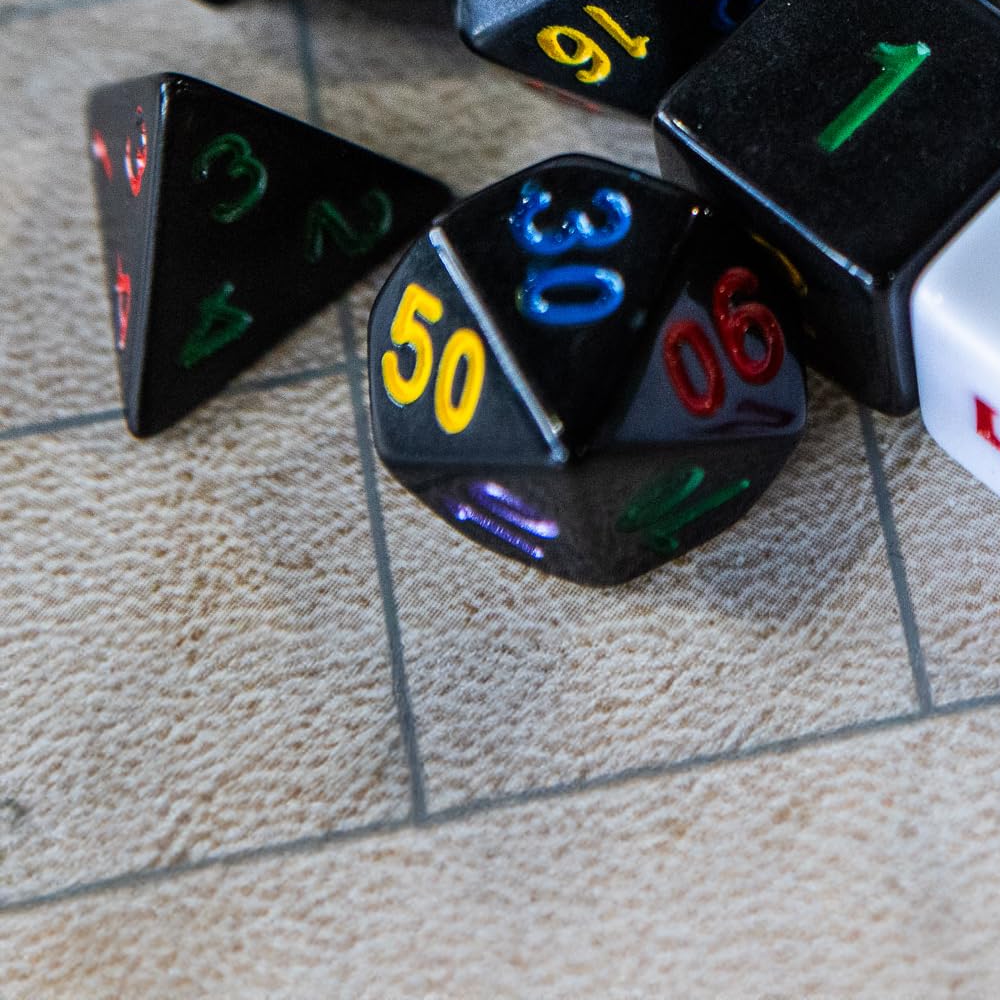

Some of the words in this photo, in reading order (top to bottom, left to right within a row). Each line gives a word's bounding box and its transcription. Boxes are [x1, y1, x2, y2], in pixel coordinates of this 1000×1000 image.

[537, 5, 650, 83] 16
[818, 40, 931, 152] 1
[193, 133, 268, 223] 3
[306, 188, 392, 264] 2
[510, 181, 632, 325] 30
[180, 281, 252, 368] 4
[382, 283, 486, 434] 50
